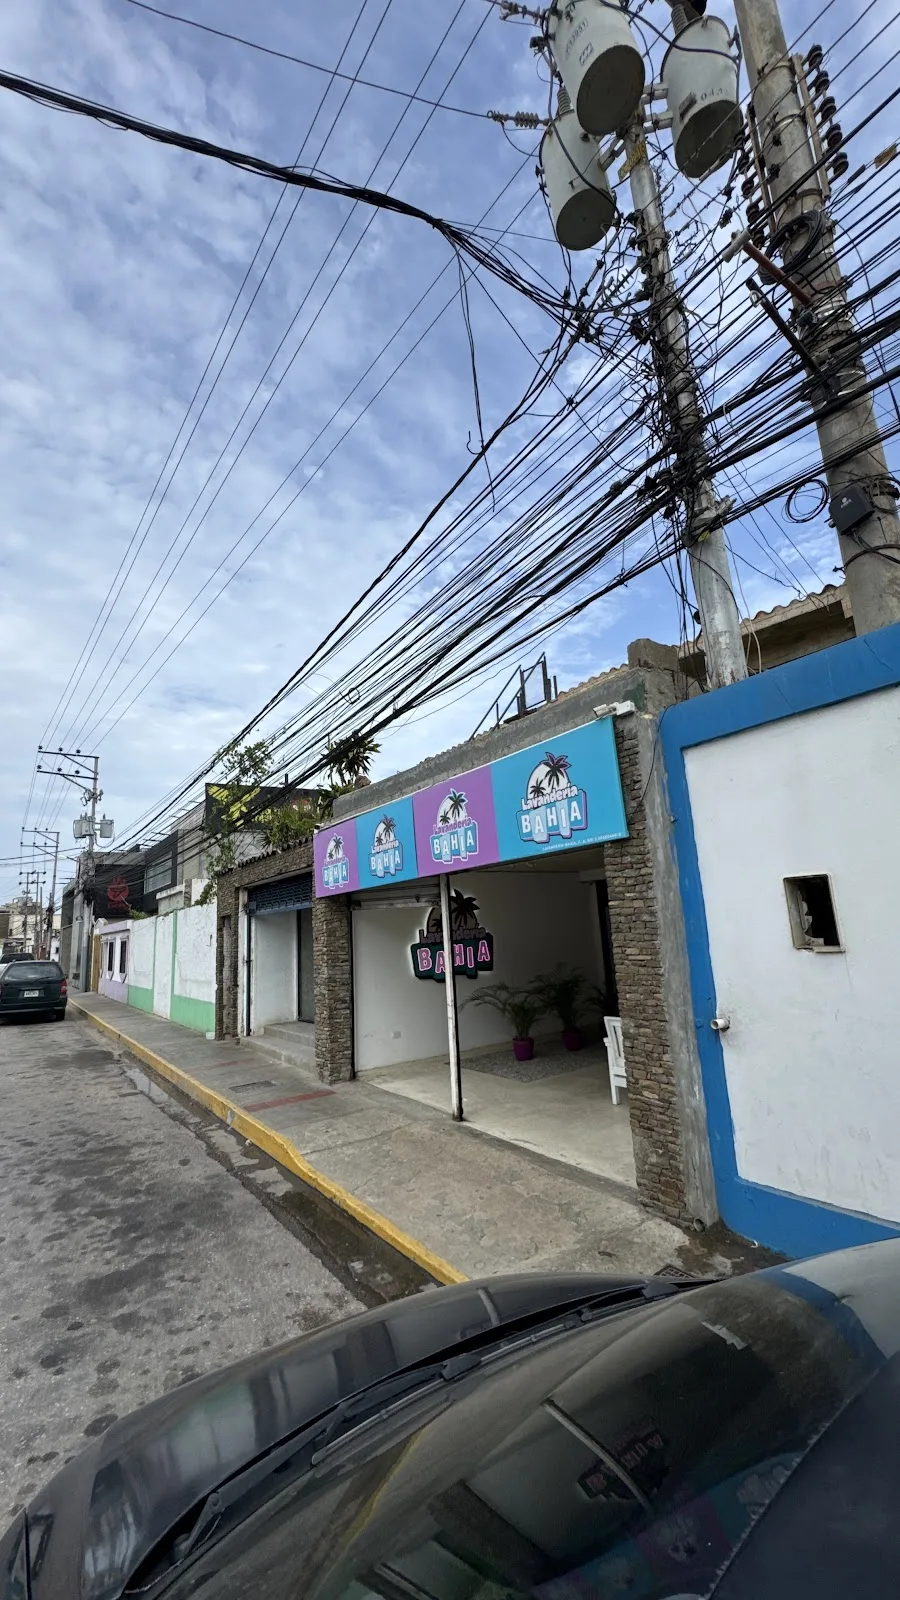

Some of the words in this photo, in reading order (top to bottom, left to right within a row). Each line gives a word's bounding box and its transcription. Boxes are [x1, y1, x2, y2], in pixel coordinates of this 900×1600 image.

[521, 800, 582, 834] BAHIA
[433, 829, 475, 855] BAHIA
[370, 849, 401, 871] BAHIA
